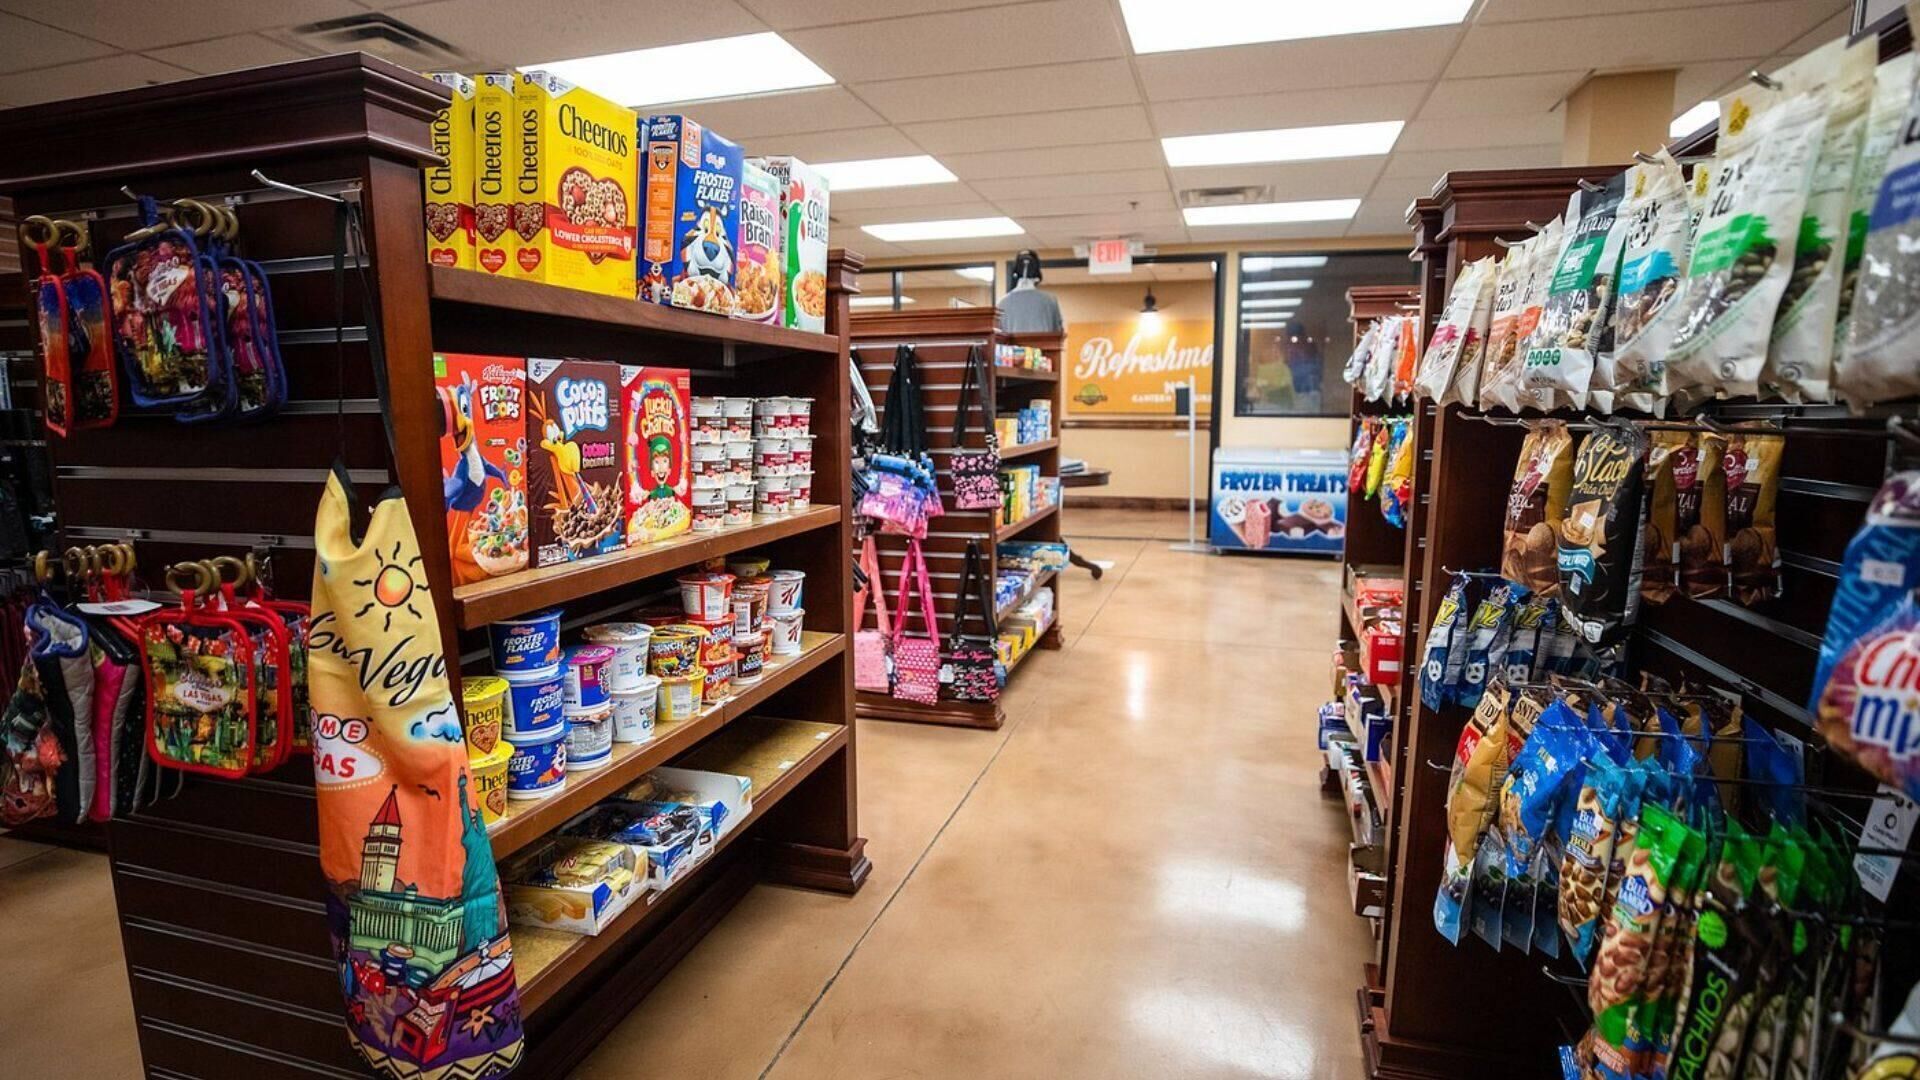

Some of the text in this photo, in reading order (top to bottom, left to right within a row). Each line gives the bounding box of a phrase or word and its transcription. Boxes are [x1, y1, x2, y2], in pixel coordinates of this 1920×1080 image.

[558, 103, 628, 158] Cheerios
[480, 110, 501, 195] Cheerios
[518, 108, 538, 195] Cheerios
[693, 169, 734, 190] FROSTED
[695, 183, 731, 202] FLAKES
[741, 201, 774, 231] Raisin
[553, 228, 581, 242] LOWER
[745, 221, 772, 249] Bran
[1097, 241, 1125, 263] EXIT
[480, 384, 520, 405] FROOT
[484, 401, 520, 421] LOOPS
[1220, 471, 1347, 494] FROZEN TREATS
[503, 631, 545, 648] FROSTED
[506, 642, 542, 654] FLAKES
